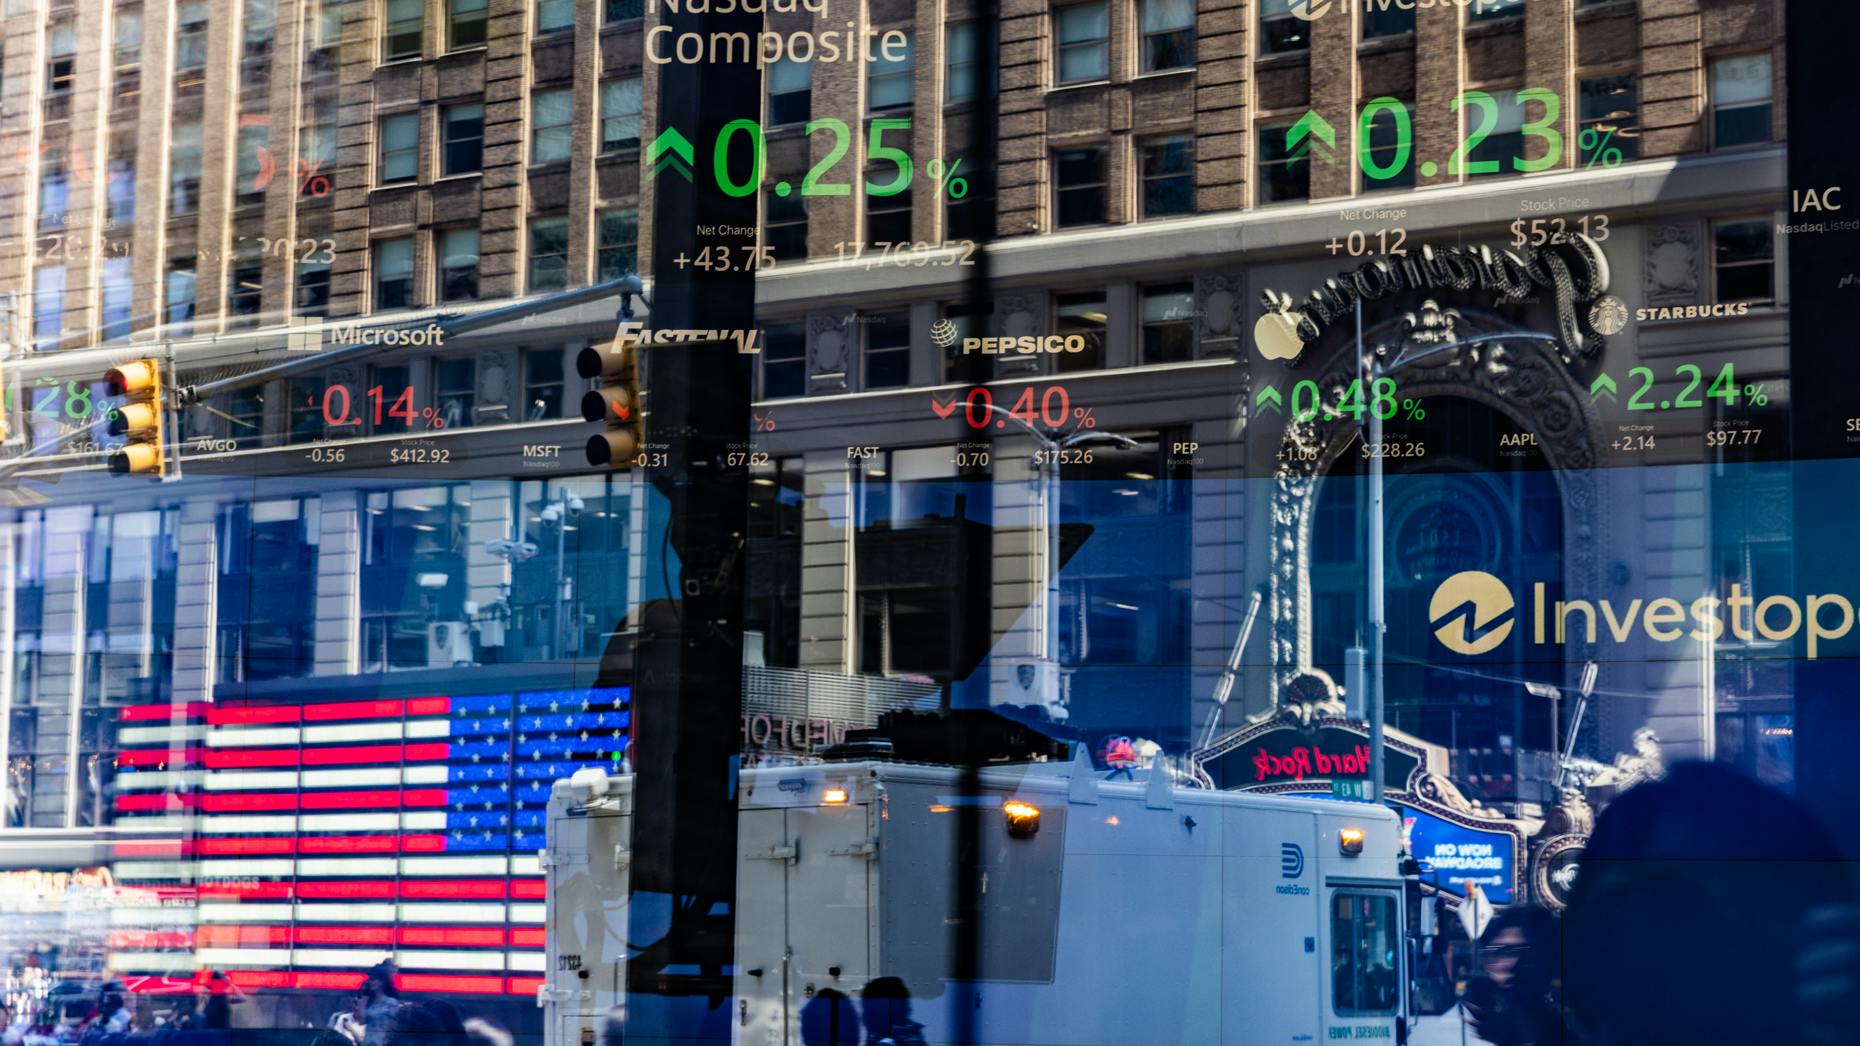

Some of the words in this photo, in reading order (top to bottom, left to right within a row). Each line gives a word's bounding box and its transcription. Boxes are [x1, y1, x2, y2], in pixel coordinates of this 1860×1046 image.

[646, 21, 908, 70] Composite
[1520, 199, 1556, 212] Stock
[1792, 186, 1842, 213] IAC
[1340, 209, 1361, 221] Net
[1362, 207, 1408, 221] Change
[696, 225, 716, 237] Net
[717, 225, 761, 239] Change
[1510, 214, 1610, 250] $5213
[1325, 227, 1408, 257] +0.12
[673, 245, 777, 273] +43.75
[1636, 302, 1749, 321] STARBUCKS
[330, 322, 445, 347] Microsoft
[963, 334, 1086, 355] PEPSICO
[196, 439, 238, 452] AVGO
[1500, 433, 1539, 446] AAPL
[1611, 435, 1657, 451] +2.14
[1706, 429, 1763, 447] $97.77
[304, 447, 345, 463] -0.56
[390, 448, 450, 464] $412.92
[523, 444, 562, 458] MSFT
[847, 446, 880, 459] FAST
[1173, 442, 1199, 455] PEP
[1361, 441, 1425, 459] $228.26
[631, 452, 669, 468] -0.31
[949, 452, 990, 467] -0.70
[1034, 449, 1094, 465] $175.26
[1533, 581, 1860, 661] Investop
